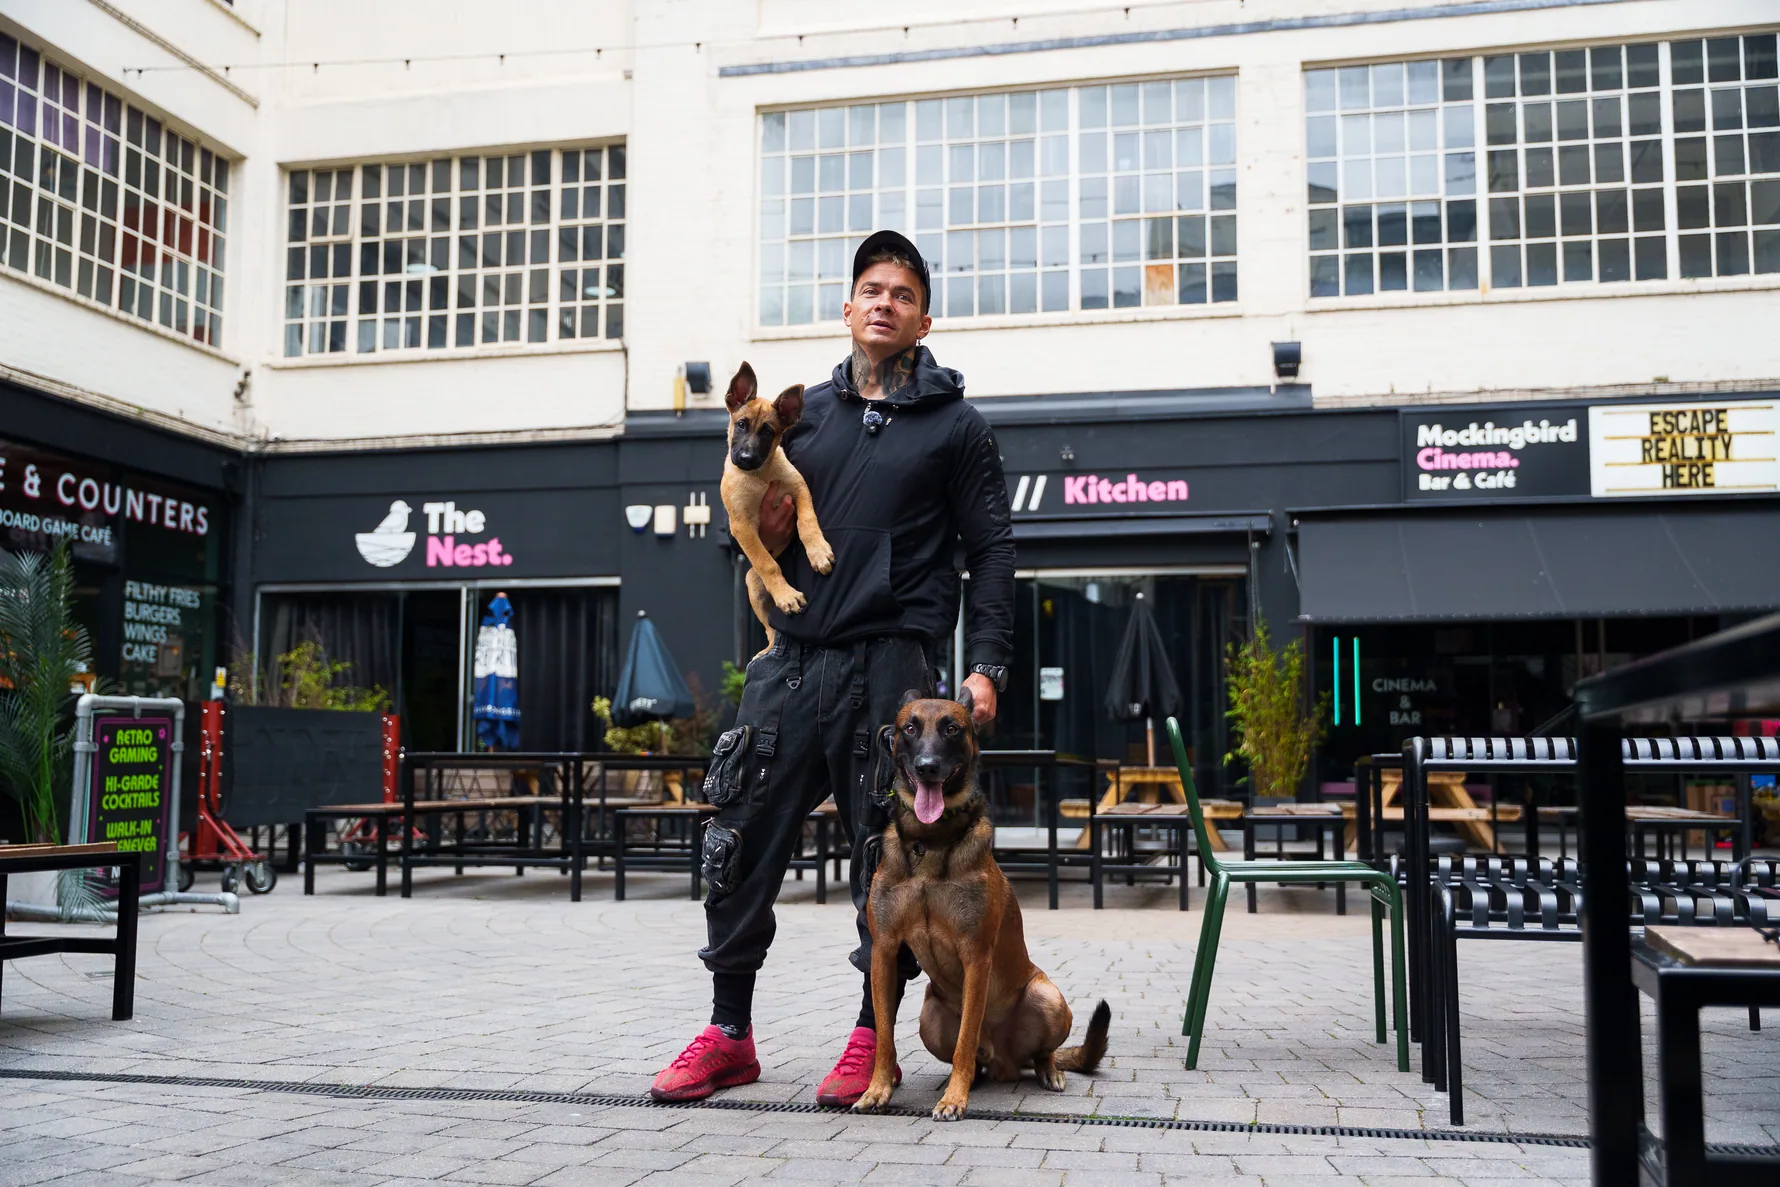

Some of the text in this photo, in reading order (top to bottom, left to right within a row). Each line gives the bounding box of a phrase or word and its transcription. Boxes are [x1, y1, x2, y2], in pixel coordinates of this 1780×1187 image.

[1650, 409, 1728, 435] ESCAPE
[1417, 419, 1577, 450] Mockingbird
[1417, 448, 1520, 471] Cinema.
[1642, 435, 1733, 462] REALITY
[1418, 470, 1517, 491] Bar & Café
[1662, 463, 1715, 488] HERE
[23, 464, 41, 497] &
[57, 472, 209, 536] COUNTERS
[1064, 474, 1189, 504] Kitchen
[423, 501, 486, 534] The
[42, 517, 79, 539] GAME
[81, 525, 112, 546] CAFÉ
[426, 535, 513, 567] Nest.
[126, 580, 200, 608] FILTHY FRIES
[125, 600, 181, 625] BURGERS
[124, 621, 167, 644] WINGS
[123, 642, 158, 663] CAKE
[1372, 677, 1437, 693] CINEMA
[1399, 695, 1412, 709] &
[1389, 711, 1422, 725] BAR
[116, 729, 153, 745] RETRO
[109, 747, 158, 764] GAMING
[105, 774, 159, 792] HI-GRADE
[102, 792, 160, 810] COCKTAILS
[106, 819, 153, 838] WALK-IN
